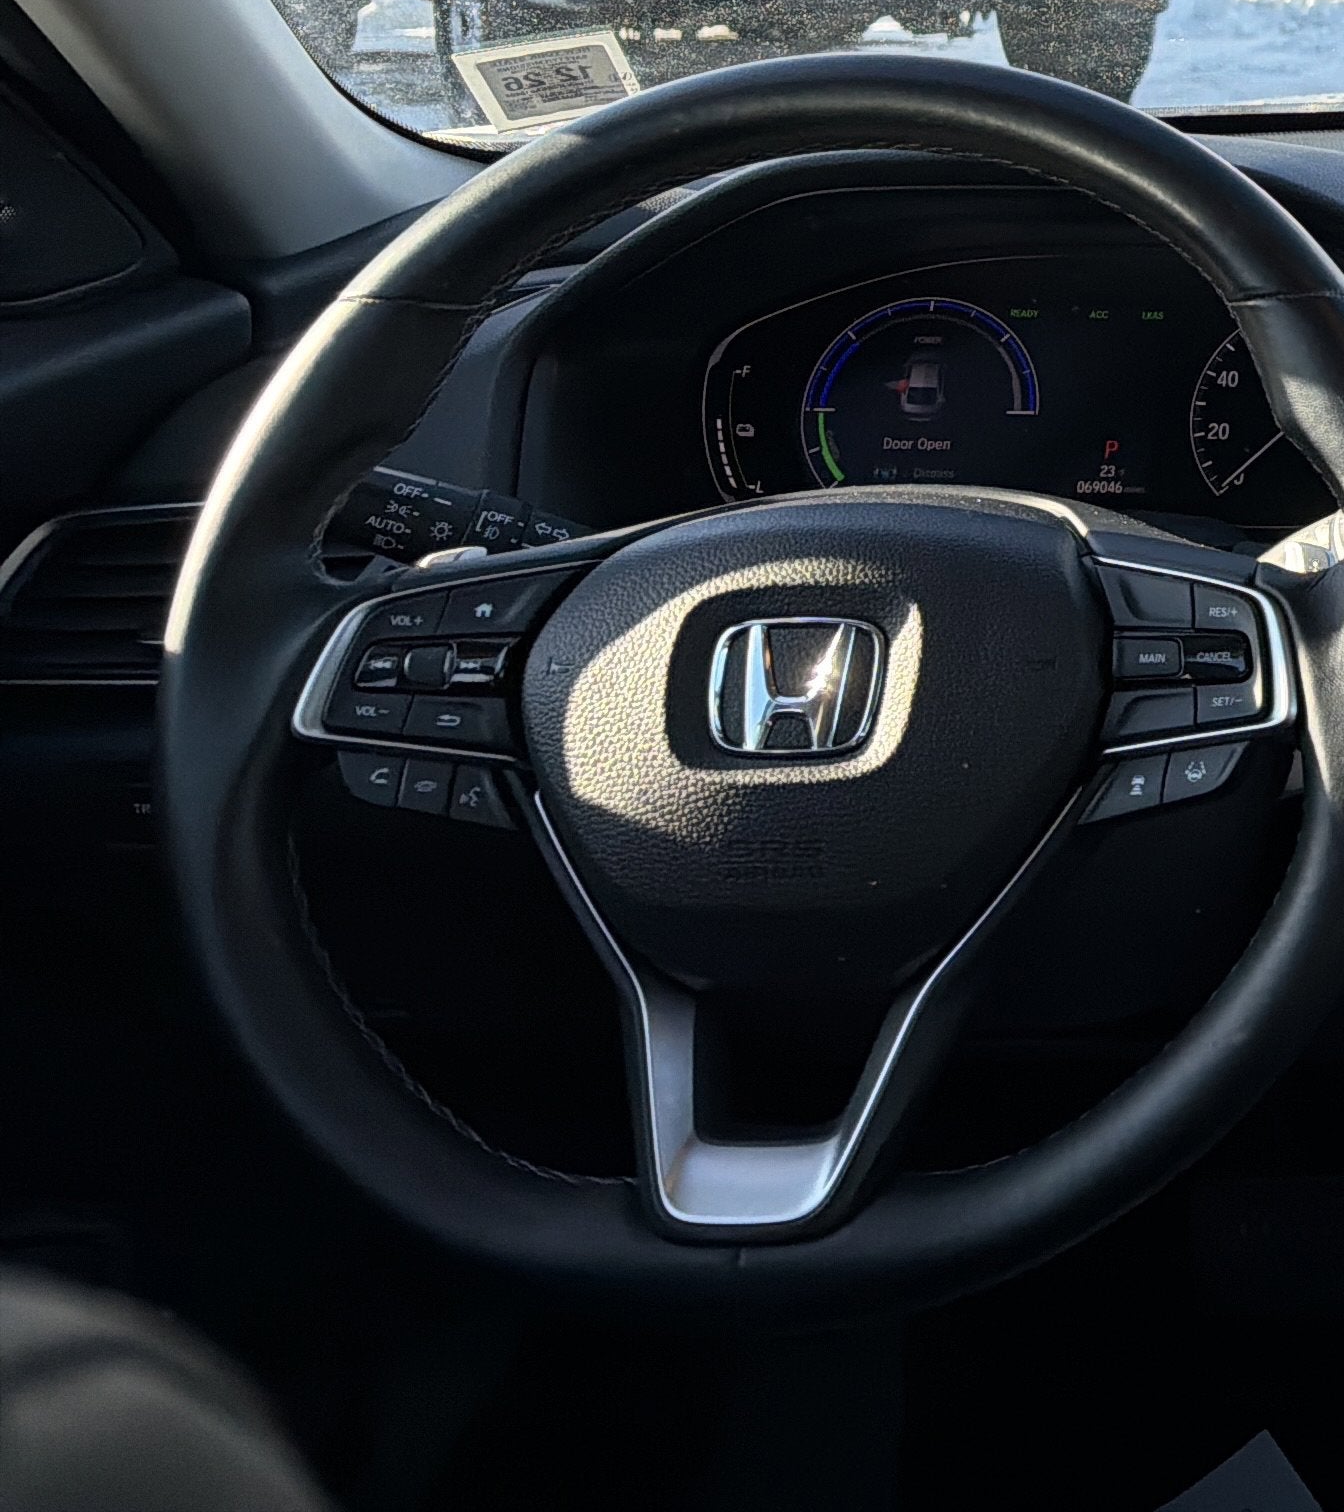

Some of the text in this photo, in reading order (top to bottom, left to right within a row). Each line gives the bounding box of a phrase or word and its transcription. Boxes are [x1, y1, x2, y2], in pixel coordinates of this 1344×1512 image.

[1010, 309, 1039, 318] READY
[1089, 311, 1109, 319] ACC
[1216, 370, 1239, 388] 40
[1207, 422, 1230, 440] 20
[883, 438, 951, 452] Door Open
[1104, 440, 1119, 459] P
[1099, 465, 1116, 478] 23
[393, 483, 422, 499] OFF
[1077, 480, 1123, 495] 069046
[365, 515, 405, 534] AUTO
[487, 510, 514, 526] OFF
[1138, 653, 1166, 665] MAIN
[1196, 651, 1233, 663] CANCEL
